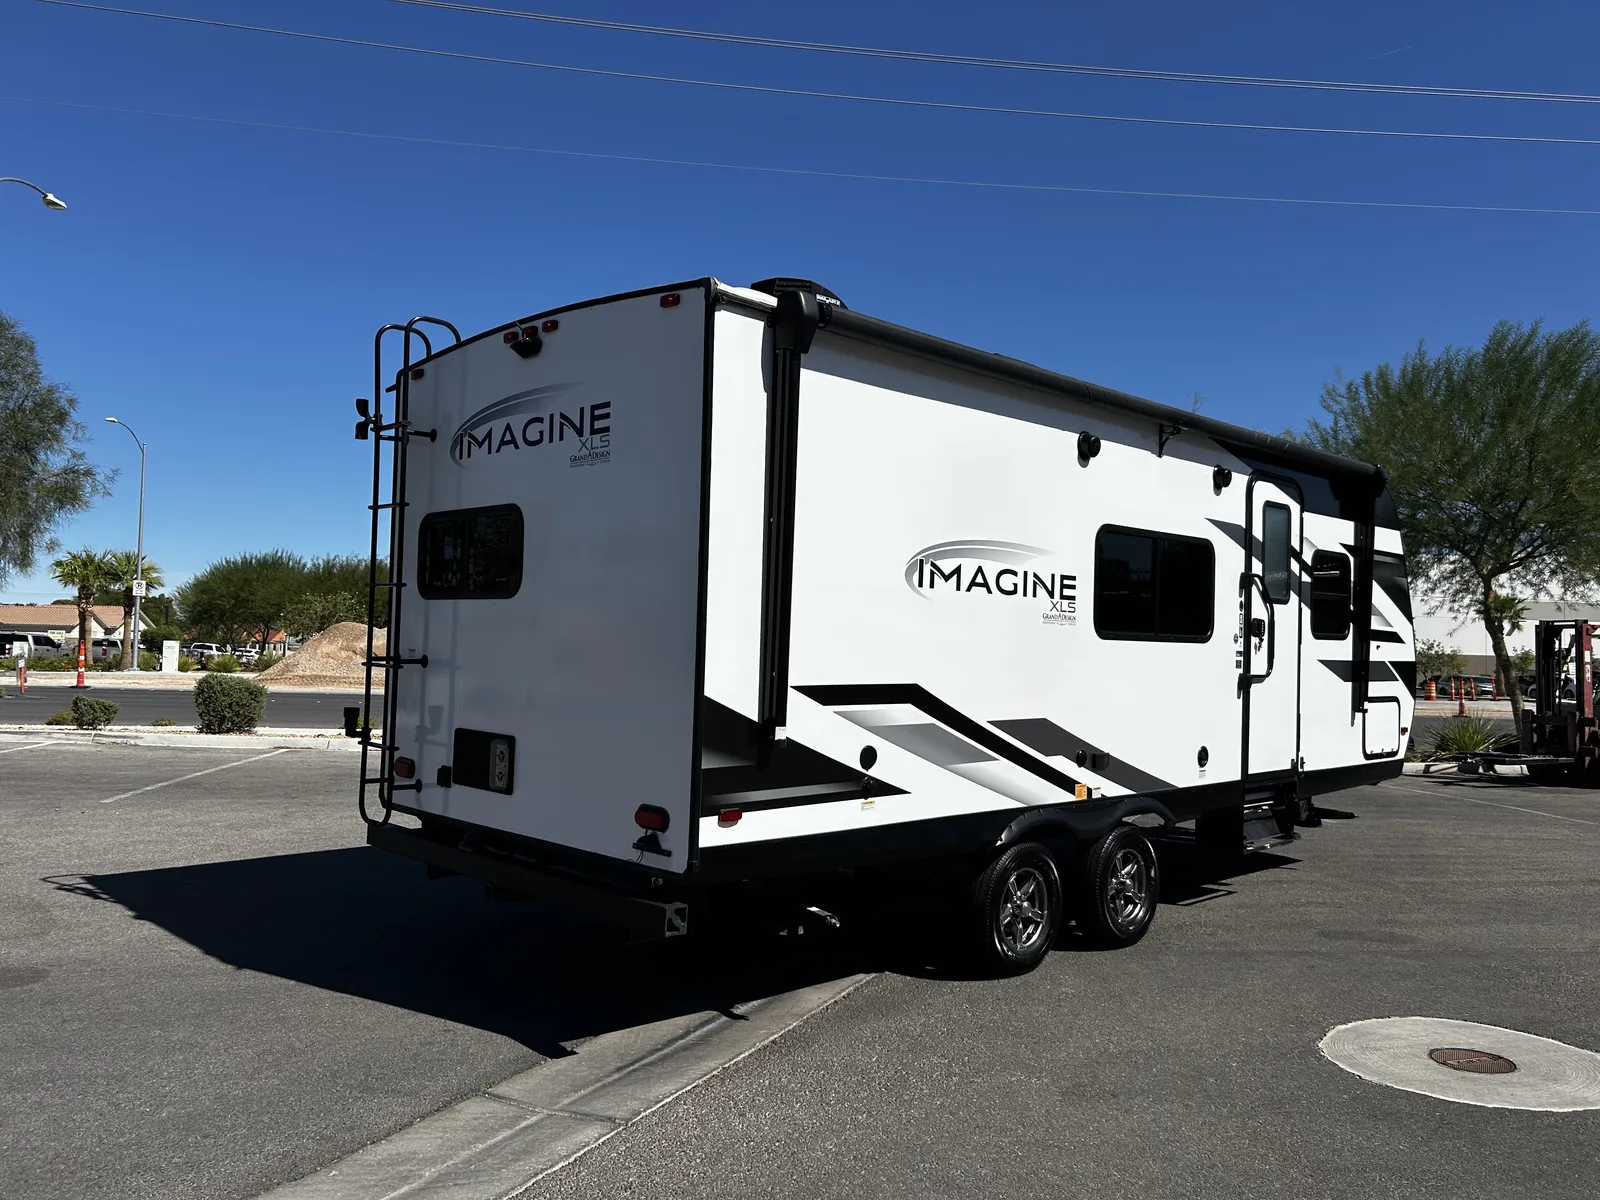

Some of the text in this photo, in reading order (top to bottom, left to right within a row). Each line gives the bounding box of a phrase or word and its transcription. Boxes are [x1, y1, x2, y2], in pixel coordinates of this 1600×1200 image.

[458, 400, 611, 461] IMAGINE
[578, 433, 610, 453] XLS
[570, 450, 611, 463] GRAND DESIGN
[917, 558, 1077, 601] IMAGINE
[1050, 600, 1076, 613] XLS
[1042, 612, 1060, 620] GRAND
